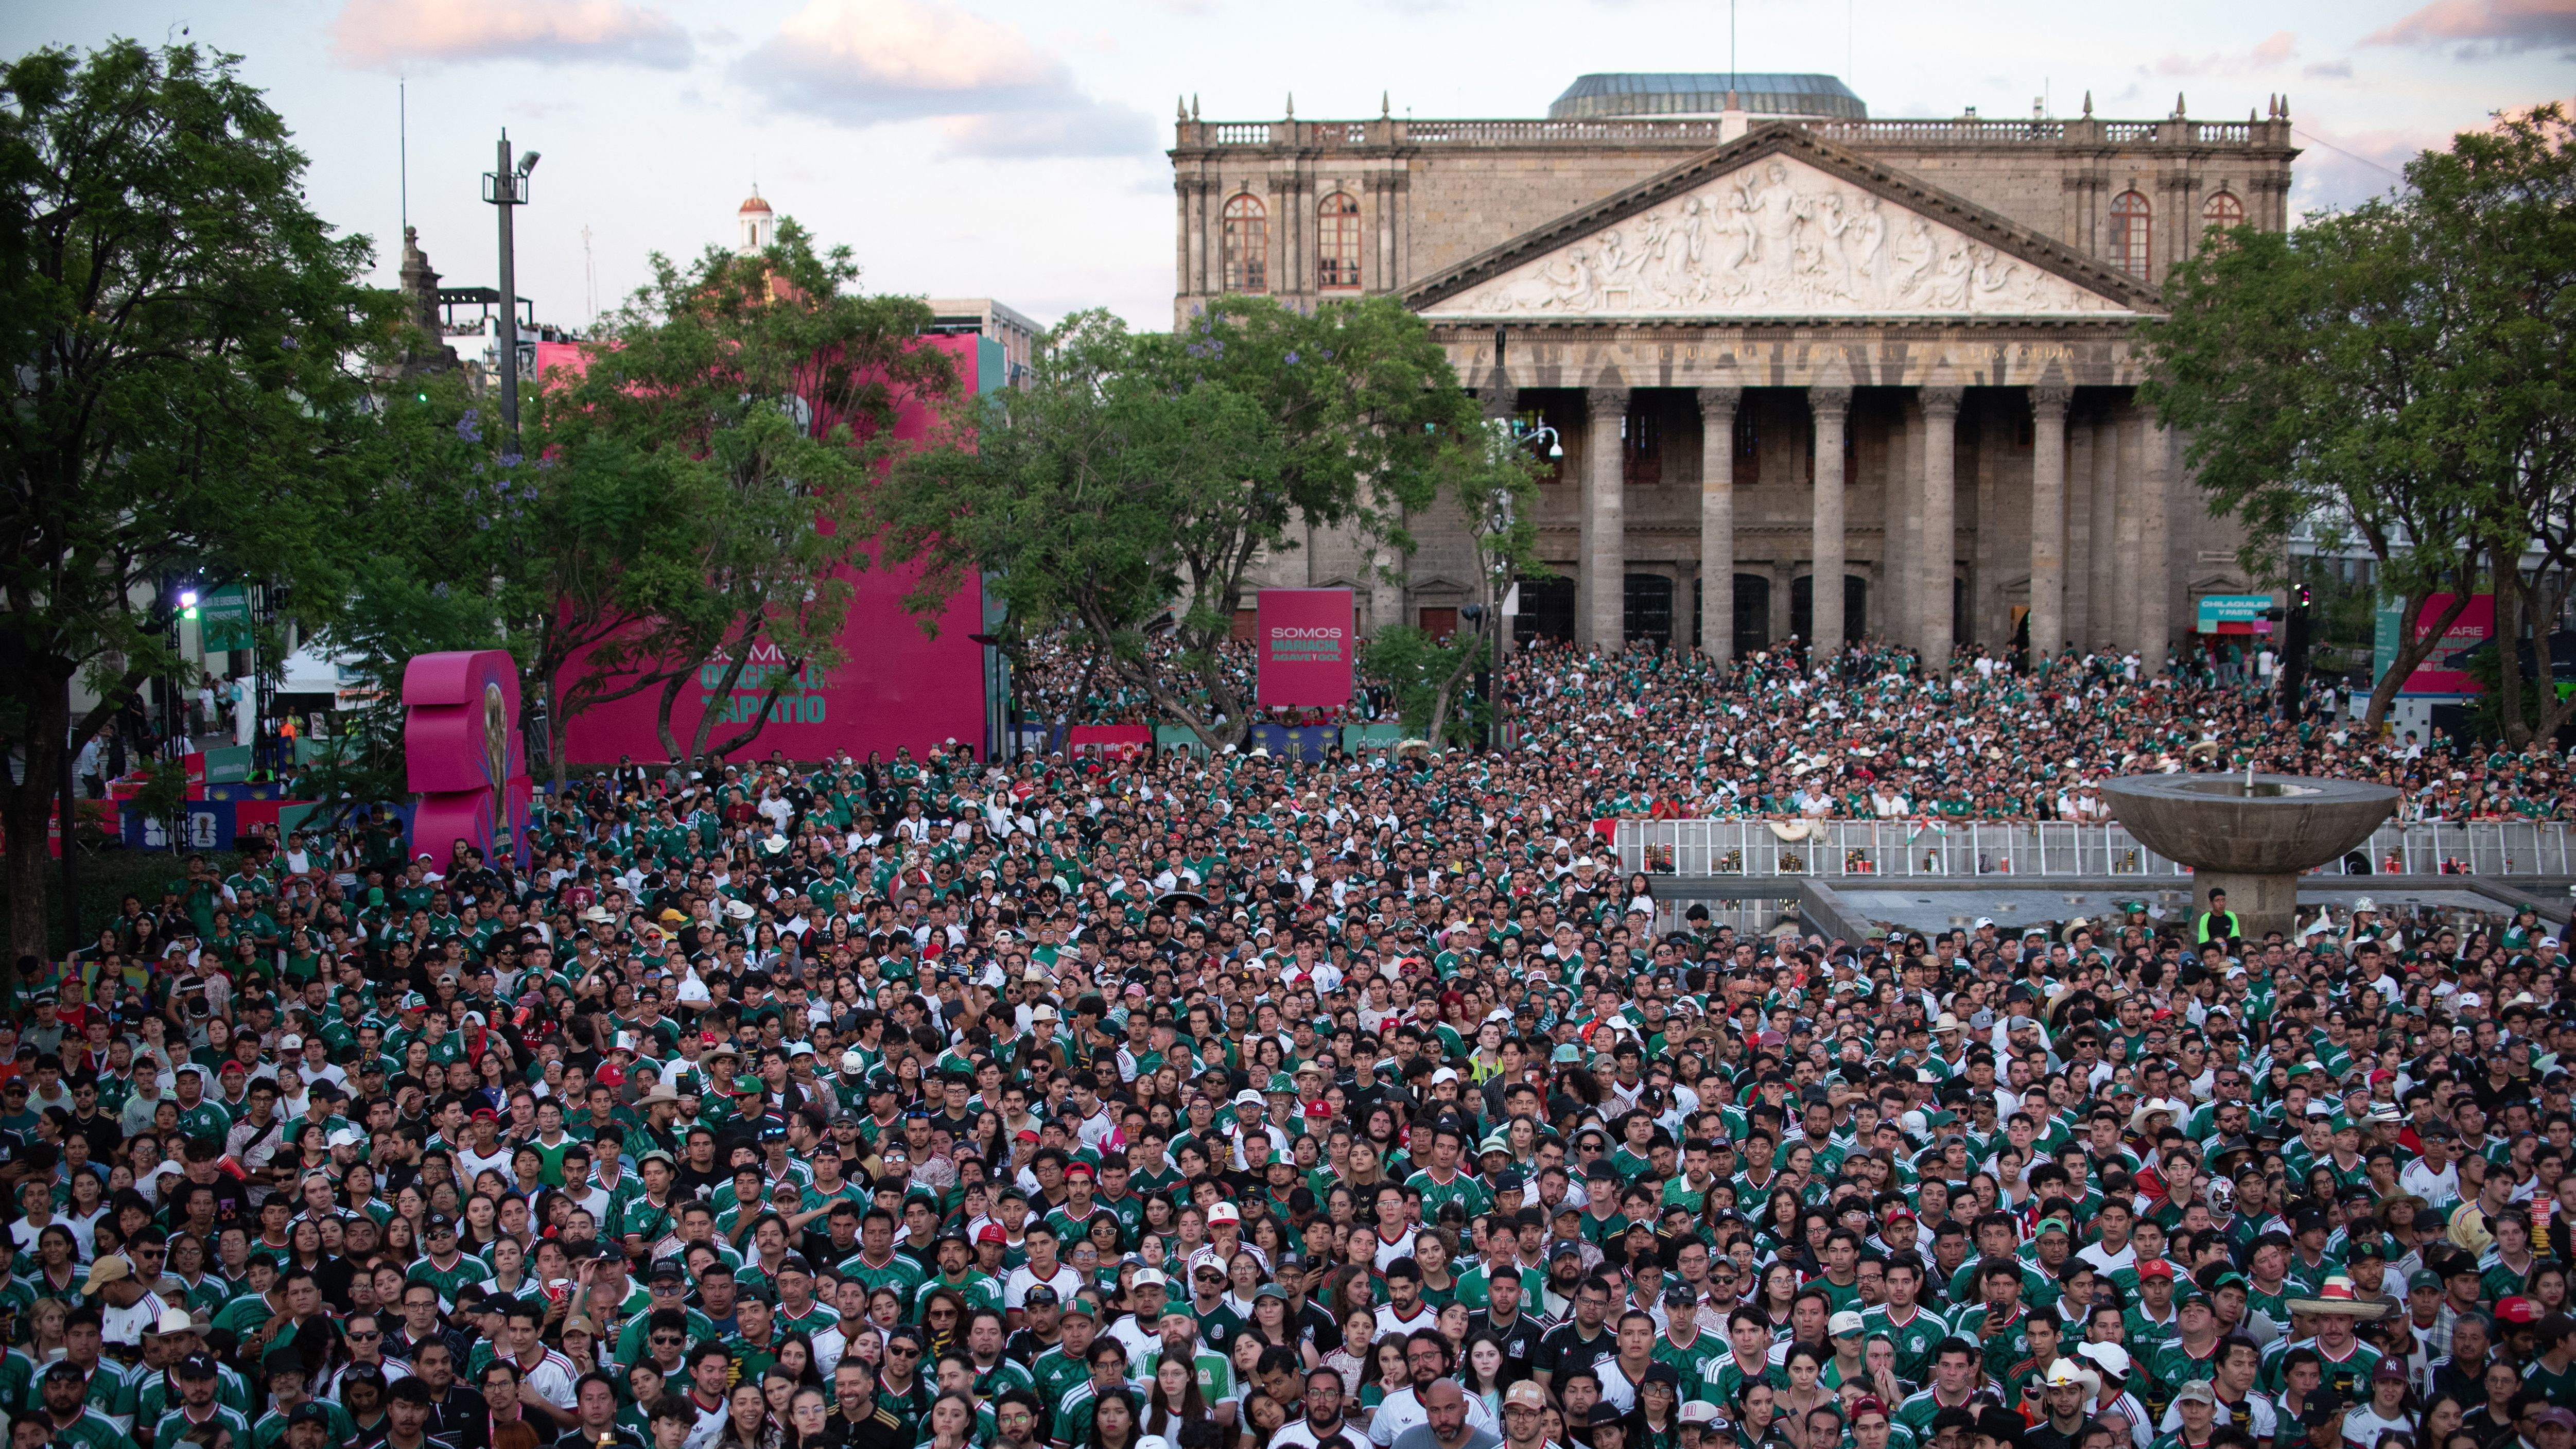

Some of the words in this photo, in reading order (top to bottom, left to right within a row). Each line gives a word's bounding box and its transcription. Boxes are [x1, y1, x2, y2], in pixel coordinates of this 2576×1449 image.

[220, 595, 248, 606] EMERGENC
[1271, 627, 1342, 638] SOMOS
[2449, 626, 2484, 636] ARE
[1272, 653, 1312, 661] AGAVE
[1318, 653, 1342, 661] GOL
[2417, 662, 2432, 672] AND
[700, 664, 826, 689] ORGULO
[846, 1063, 864, 1072] ドジャース
[1315, 1103, 1324, 1111] NY
[2345, 1117, 2354, 1125] NY
[994, 1167, 1002, 1178] SF
[1722, 1208, 1732, 1216] NY
[990, 1226, 998, 1237] A
[1961, 1333, 1971, 1342] LA
[2385, 1359, 2397, 1371] NY
[2304, 1402, 2314, 1411] GOL
